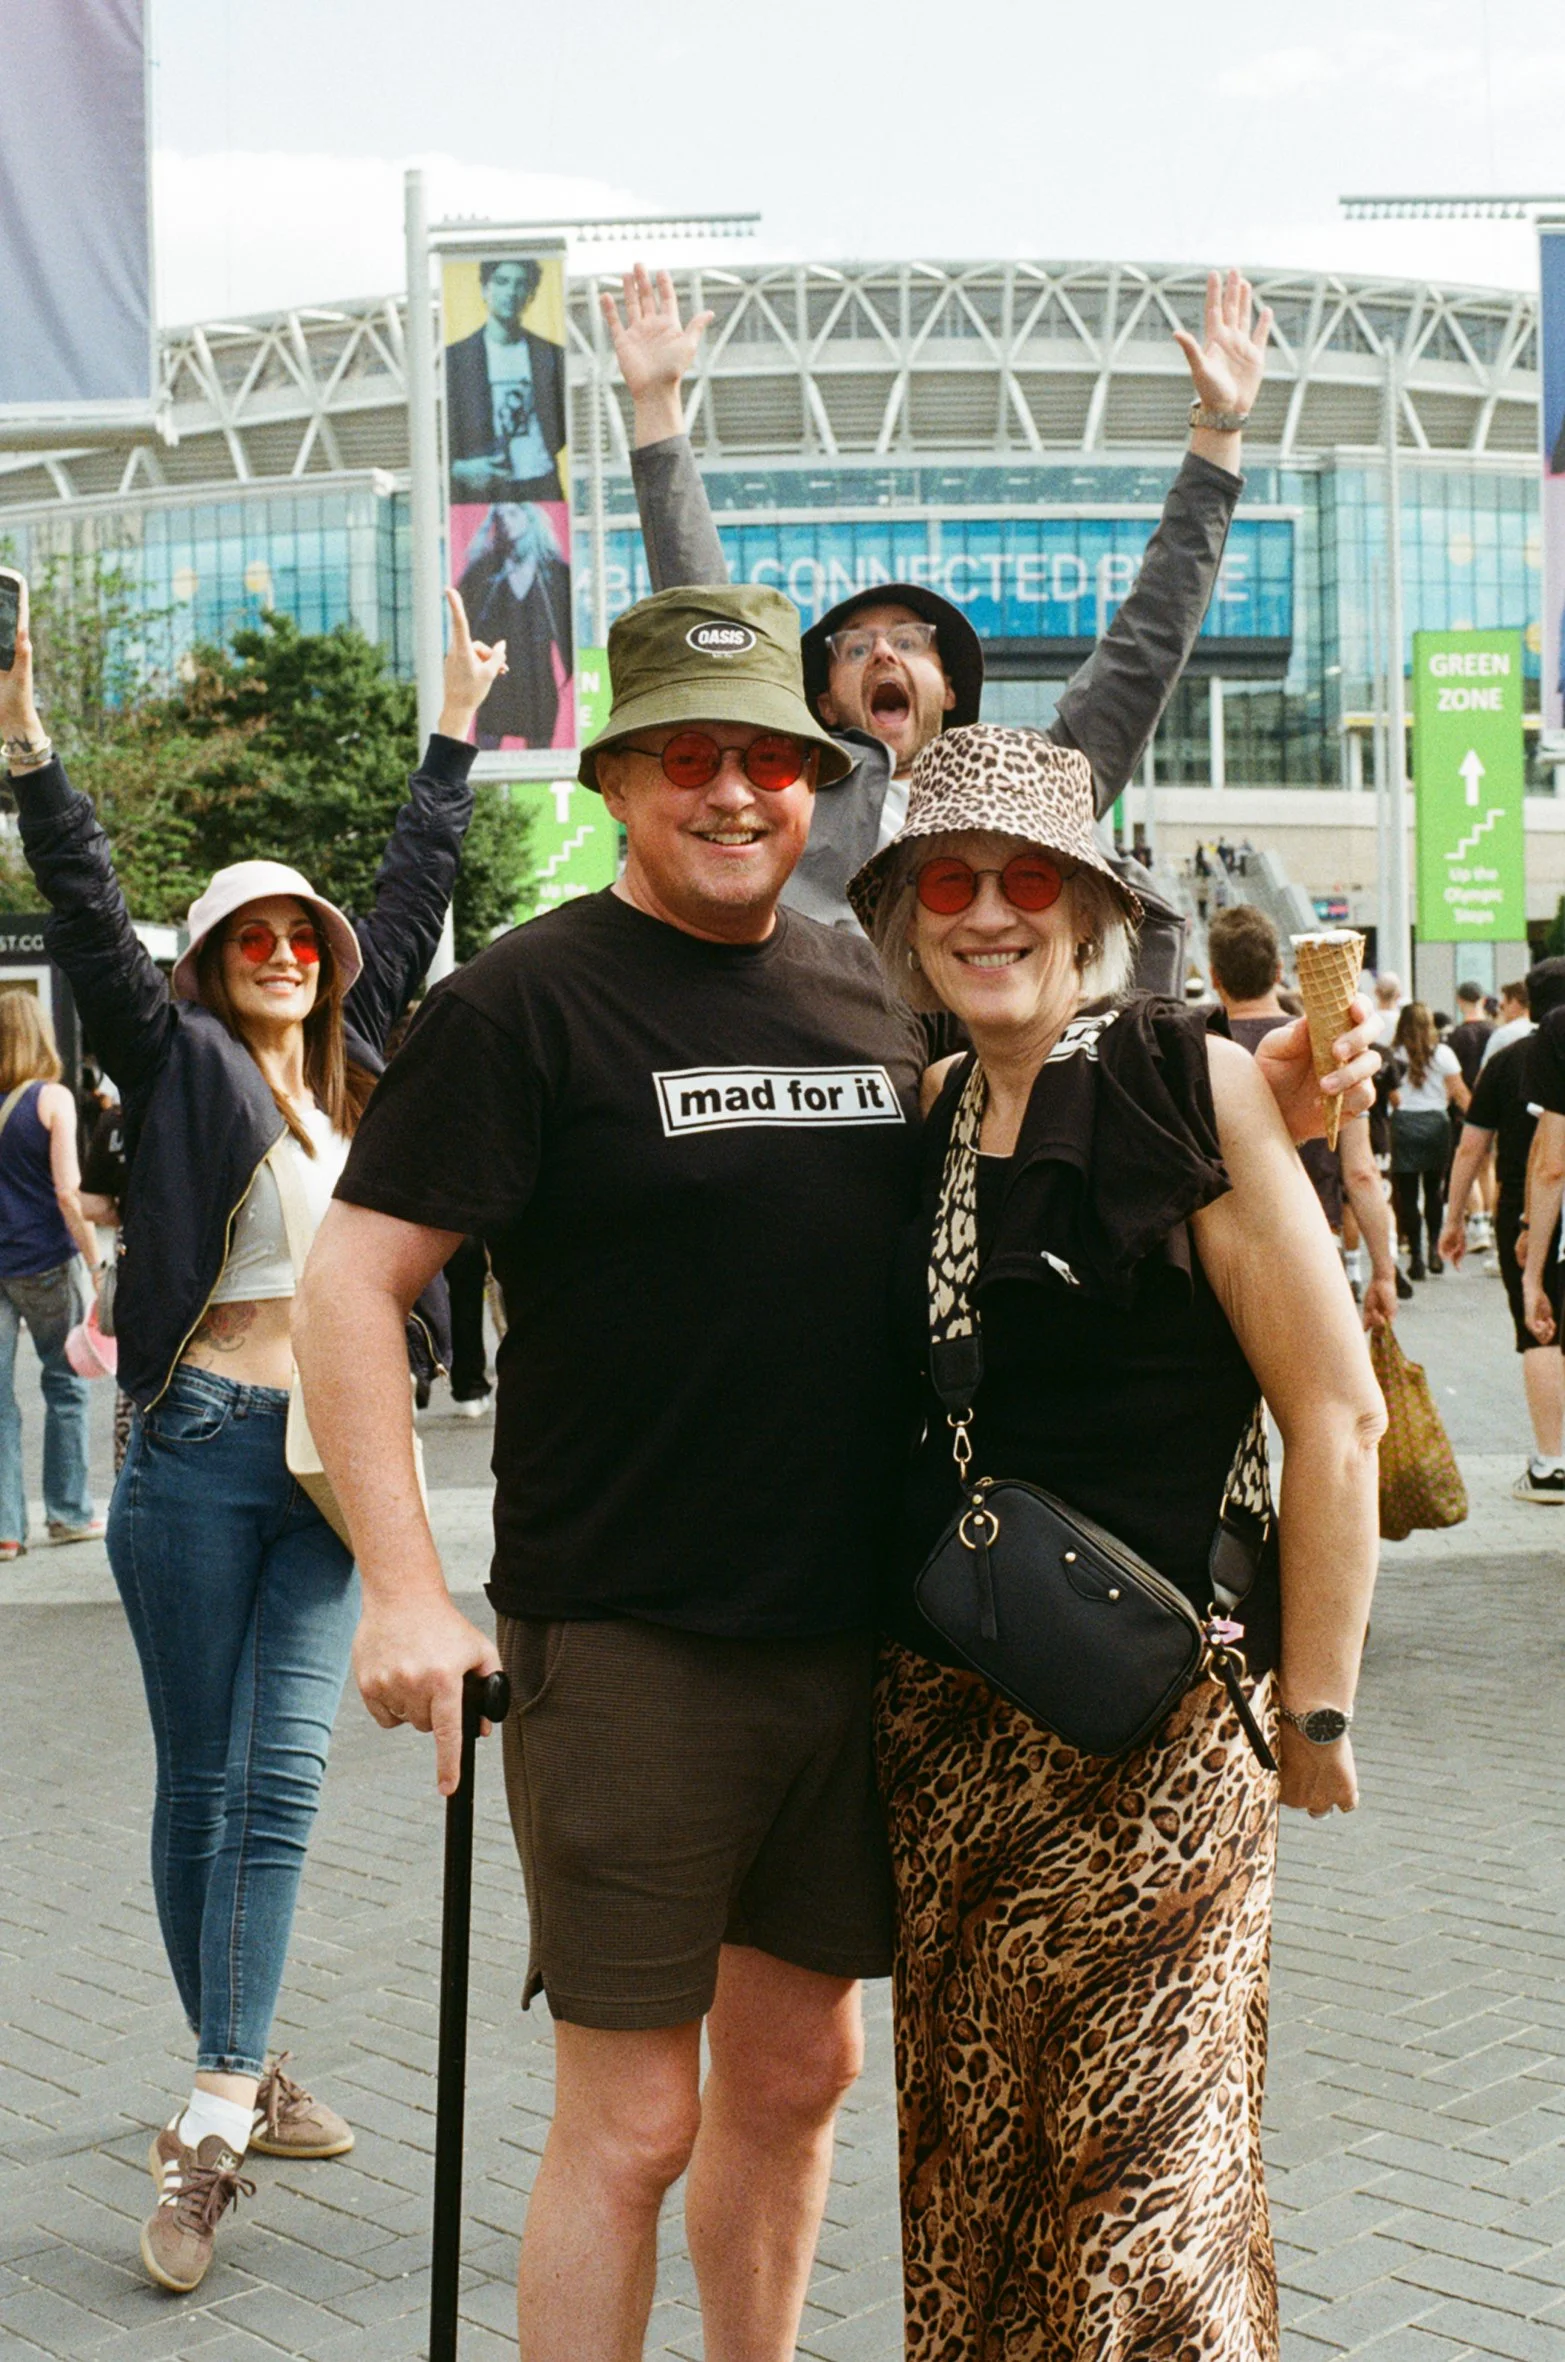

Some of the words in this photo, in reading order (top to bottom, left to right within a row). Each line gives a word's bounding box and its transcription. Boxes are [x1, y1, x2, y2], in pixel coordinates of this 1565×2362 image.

[750, 552, 1088, 606] CONNECTED
[697, 629, 745, 645] OASIS
[1429, 653, 1510, 677] GREEN
[1437, 687, 1504, 712] ZONE
[680, 1079, 776, 1117] mad
[786, 1080, 843, 1111] for
[854, 1078, 885, 1109] it
